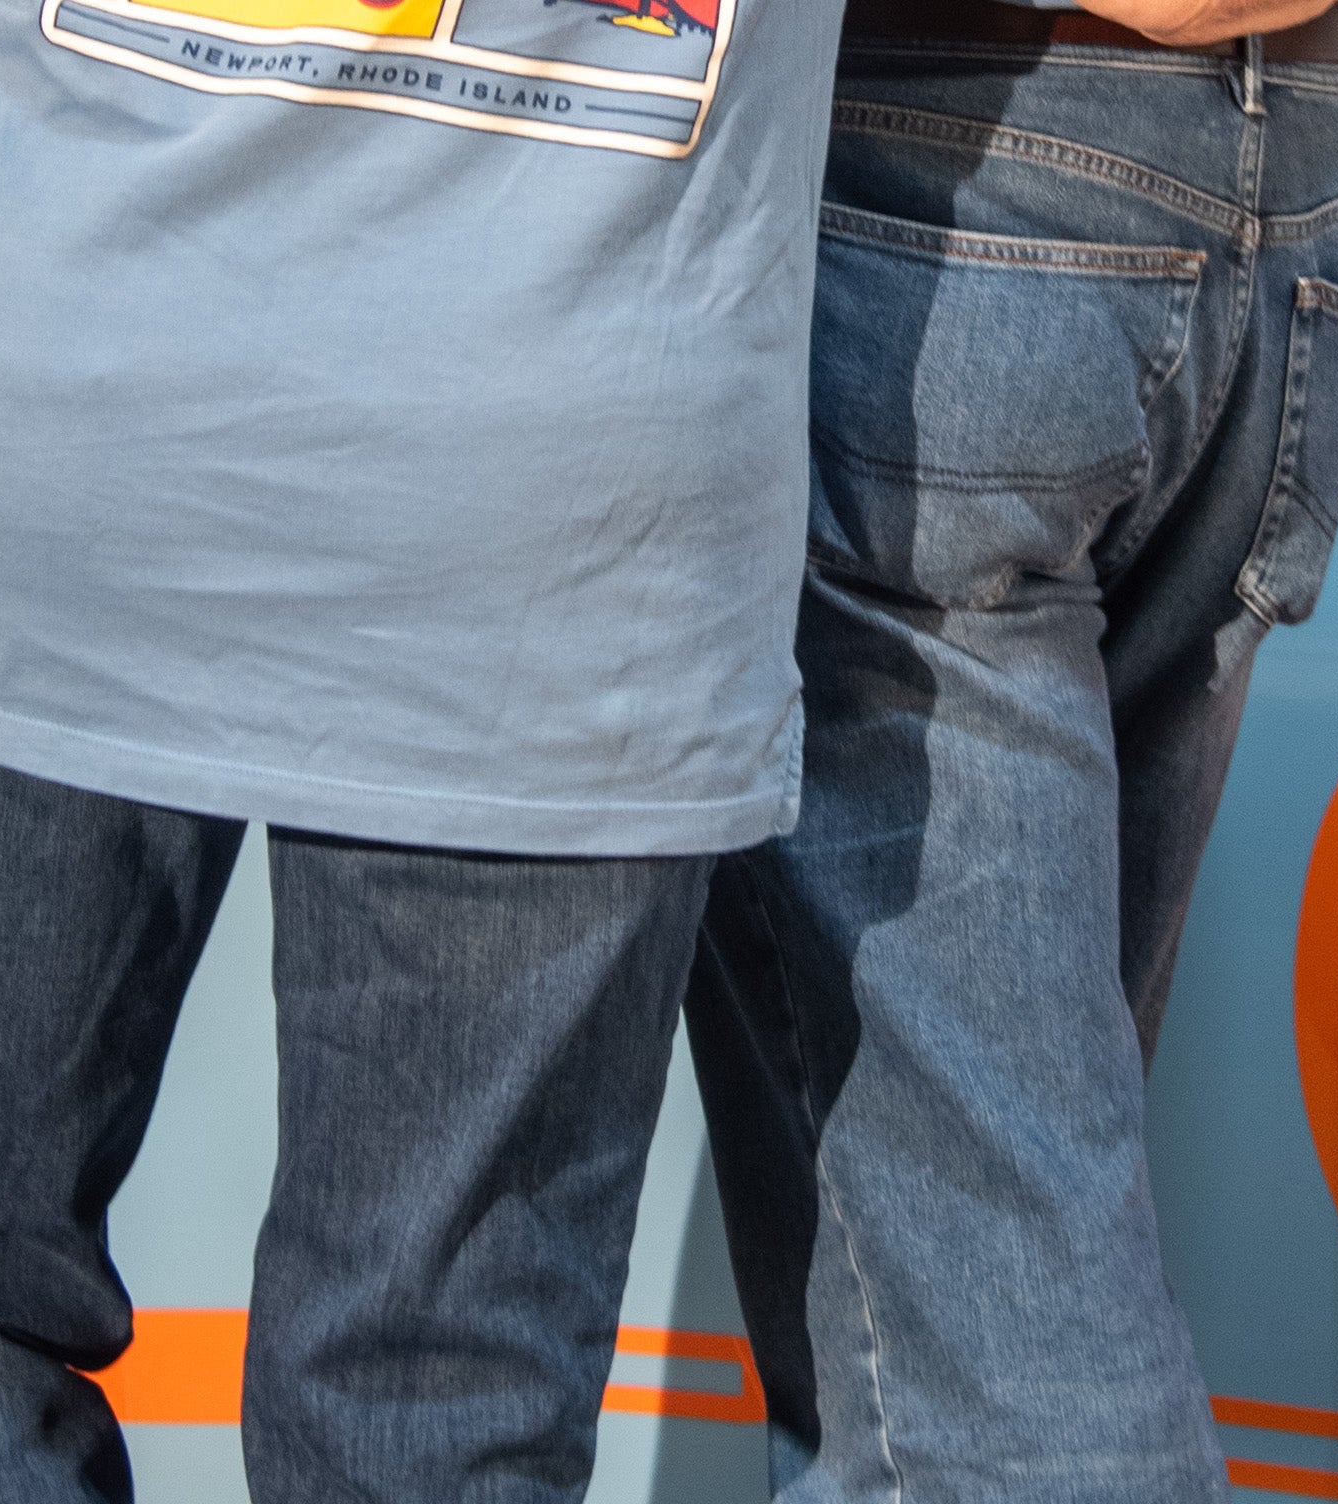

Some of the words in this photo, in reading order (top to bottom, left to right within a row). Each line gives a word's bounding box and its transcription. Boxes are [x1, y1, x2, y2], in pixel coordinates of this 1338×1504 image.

[180, 39, 321, 78] NEWPORT,
[337, 63, 443, 92] RHODE
[460, 78, 574, 114] ISLAND
